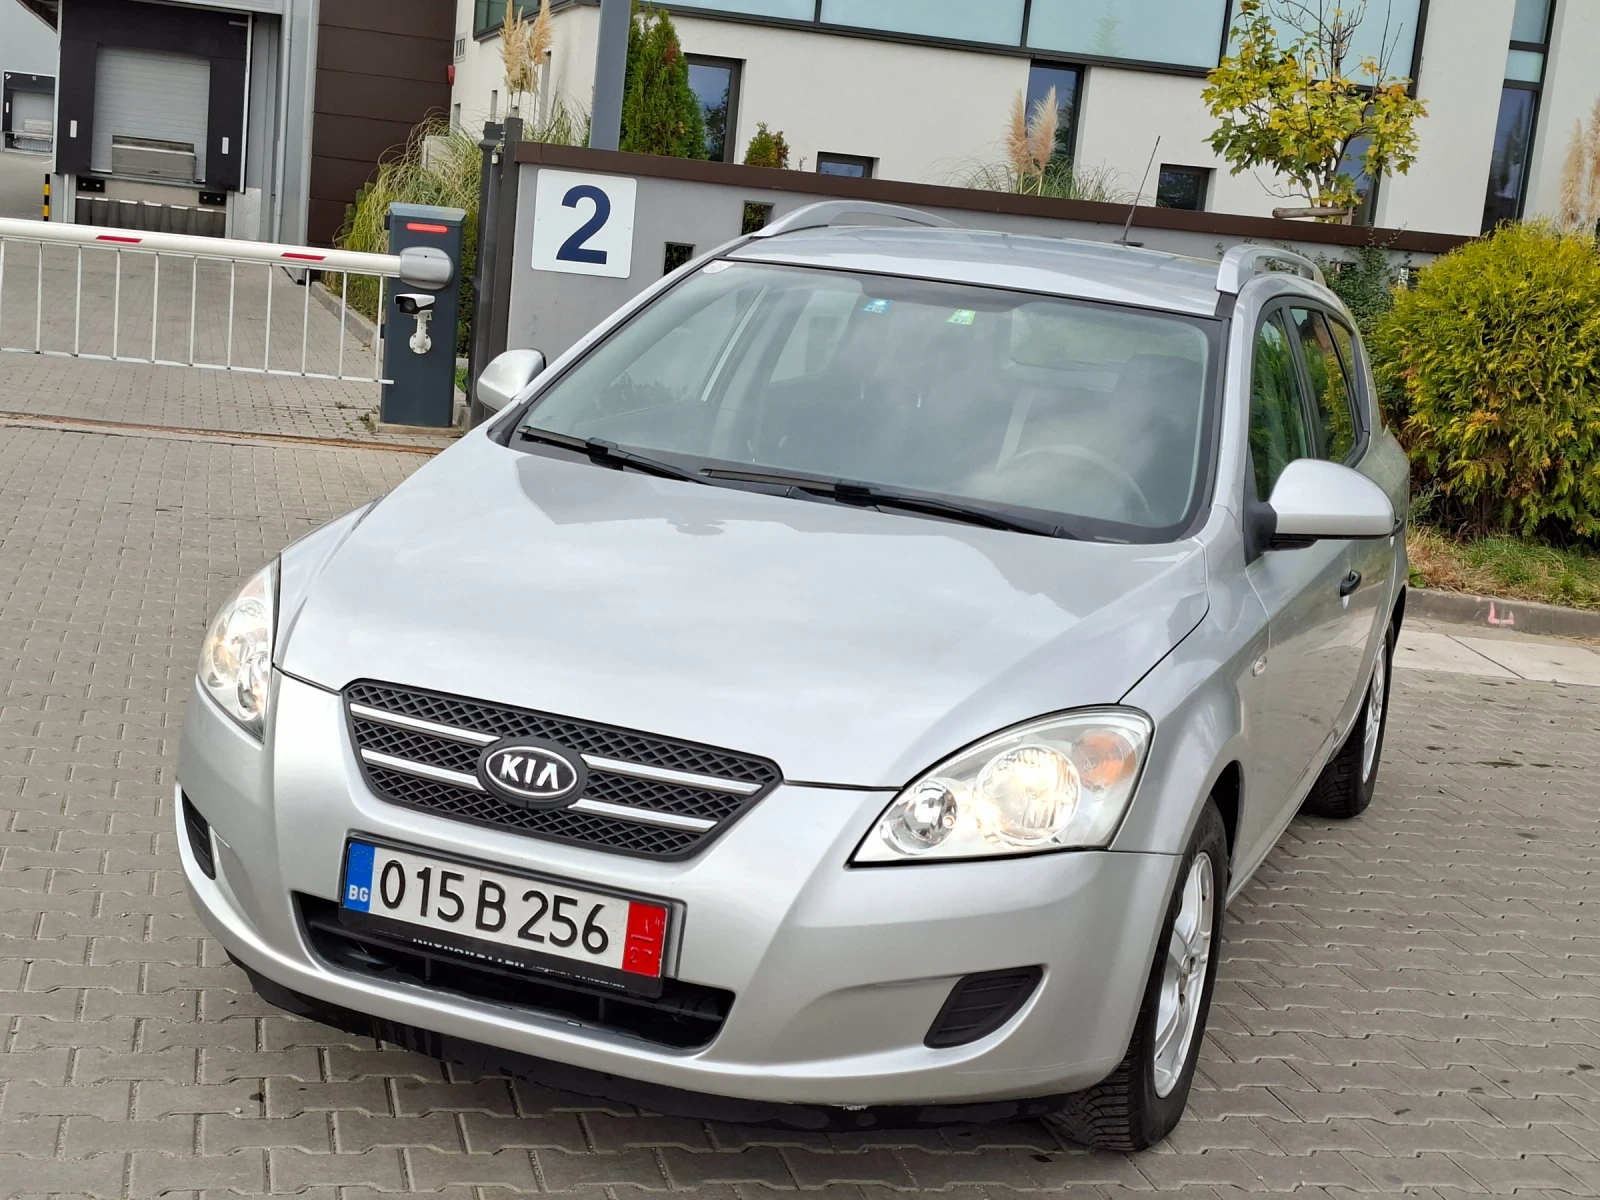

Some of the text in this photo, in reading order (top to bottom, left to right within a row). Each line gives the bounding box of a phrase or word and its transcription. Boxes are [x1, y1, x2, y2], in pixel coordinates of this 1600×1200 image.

[556, 185, 611, 264] 2
[499, 754, 559, 790] KIA
[348, 885, 369, 903] BG
[380, 859, 465, 923] 015
[475, 880, 507, 933] B
[518, 890, 609, 955] 256
